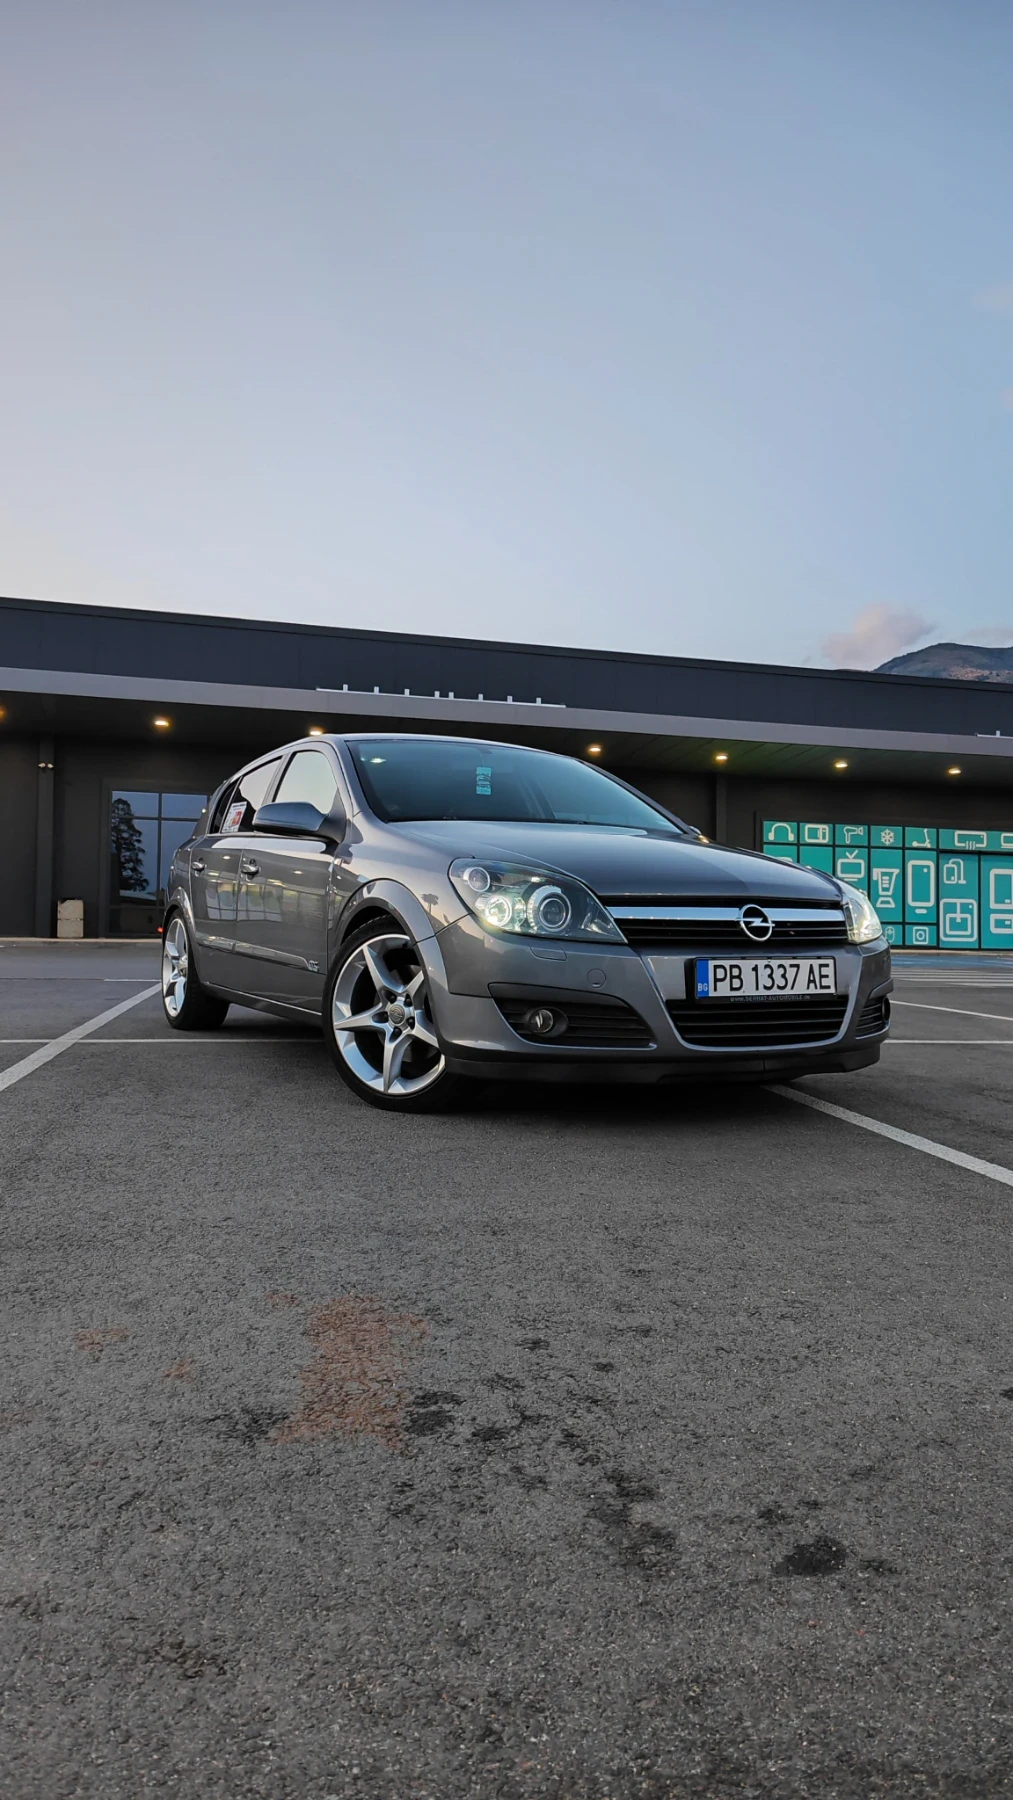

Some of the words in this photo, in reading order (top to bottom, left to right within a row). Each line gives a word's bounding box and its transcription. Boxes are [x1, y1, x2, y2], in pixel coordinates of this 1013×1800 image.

[713, 964, 744, 992] PB
[751, 963, 800, 991] 1337
[806, 963, 831, 990] AE
[697, 983, 708, 992] BG
